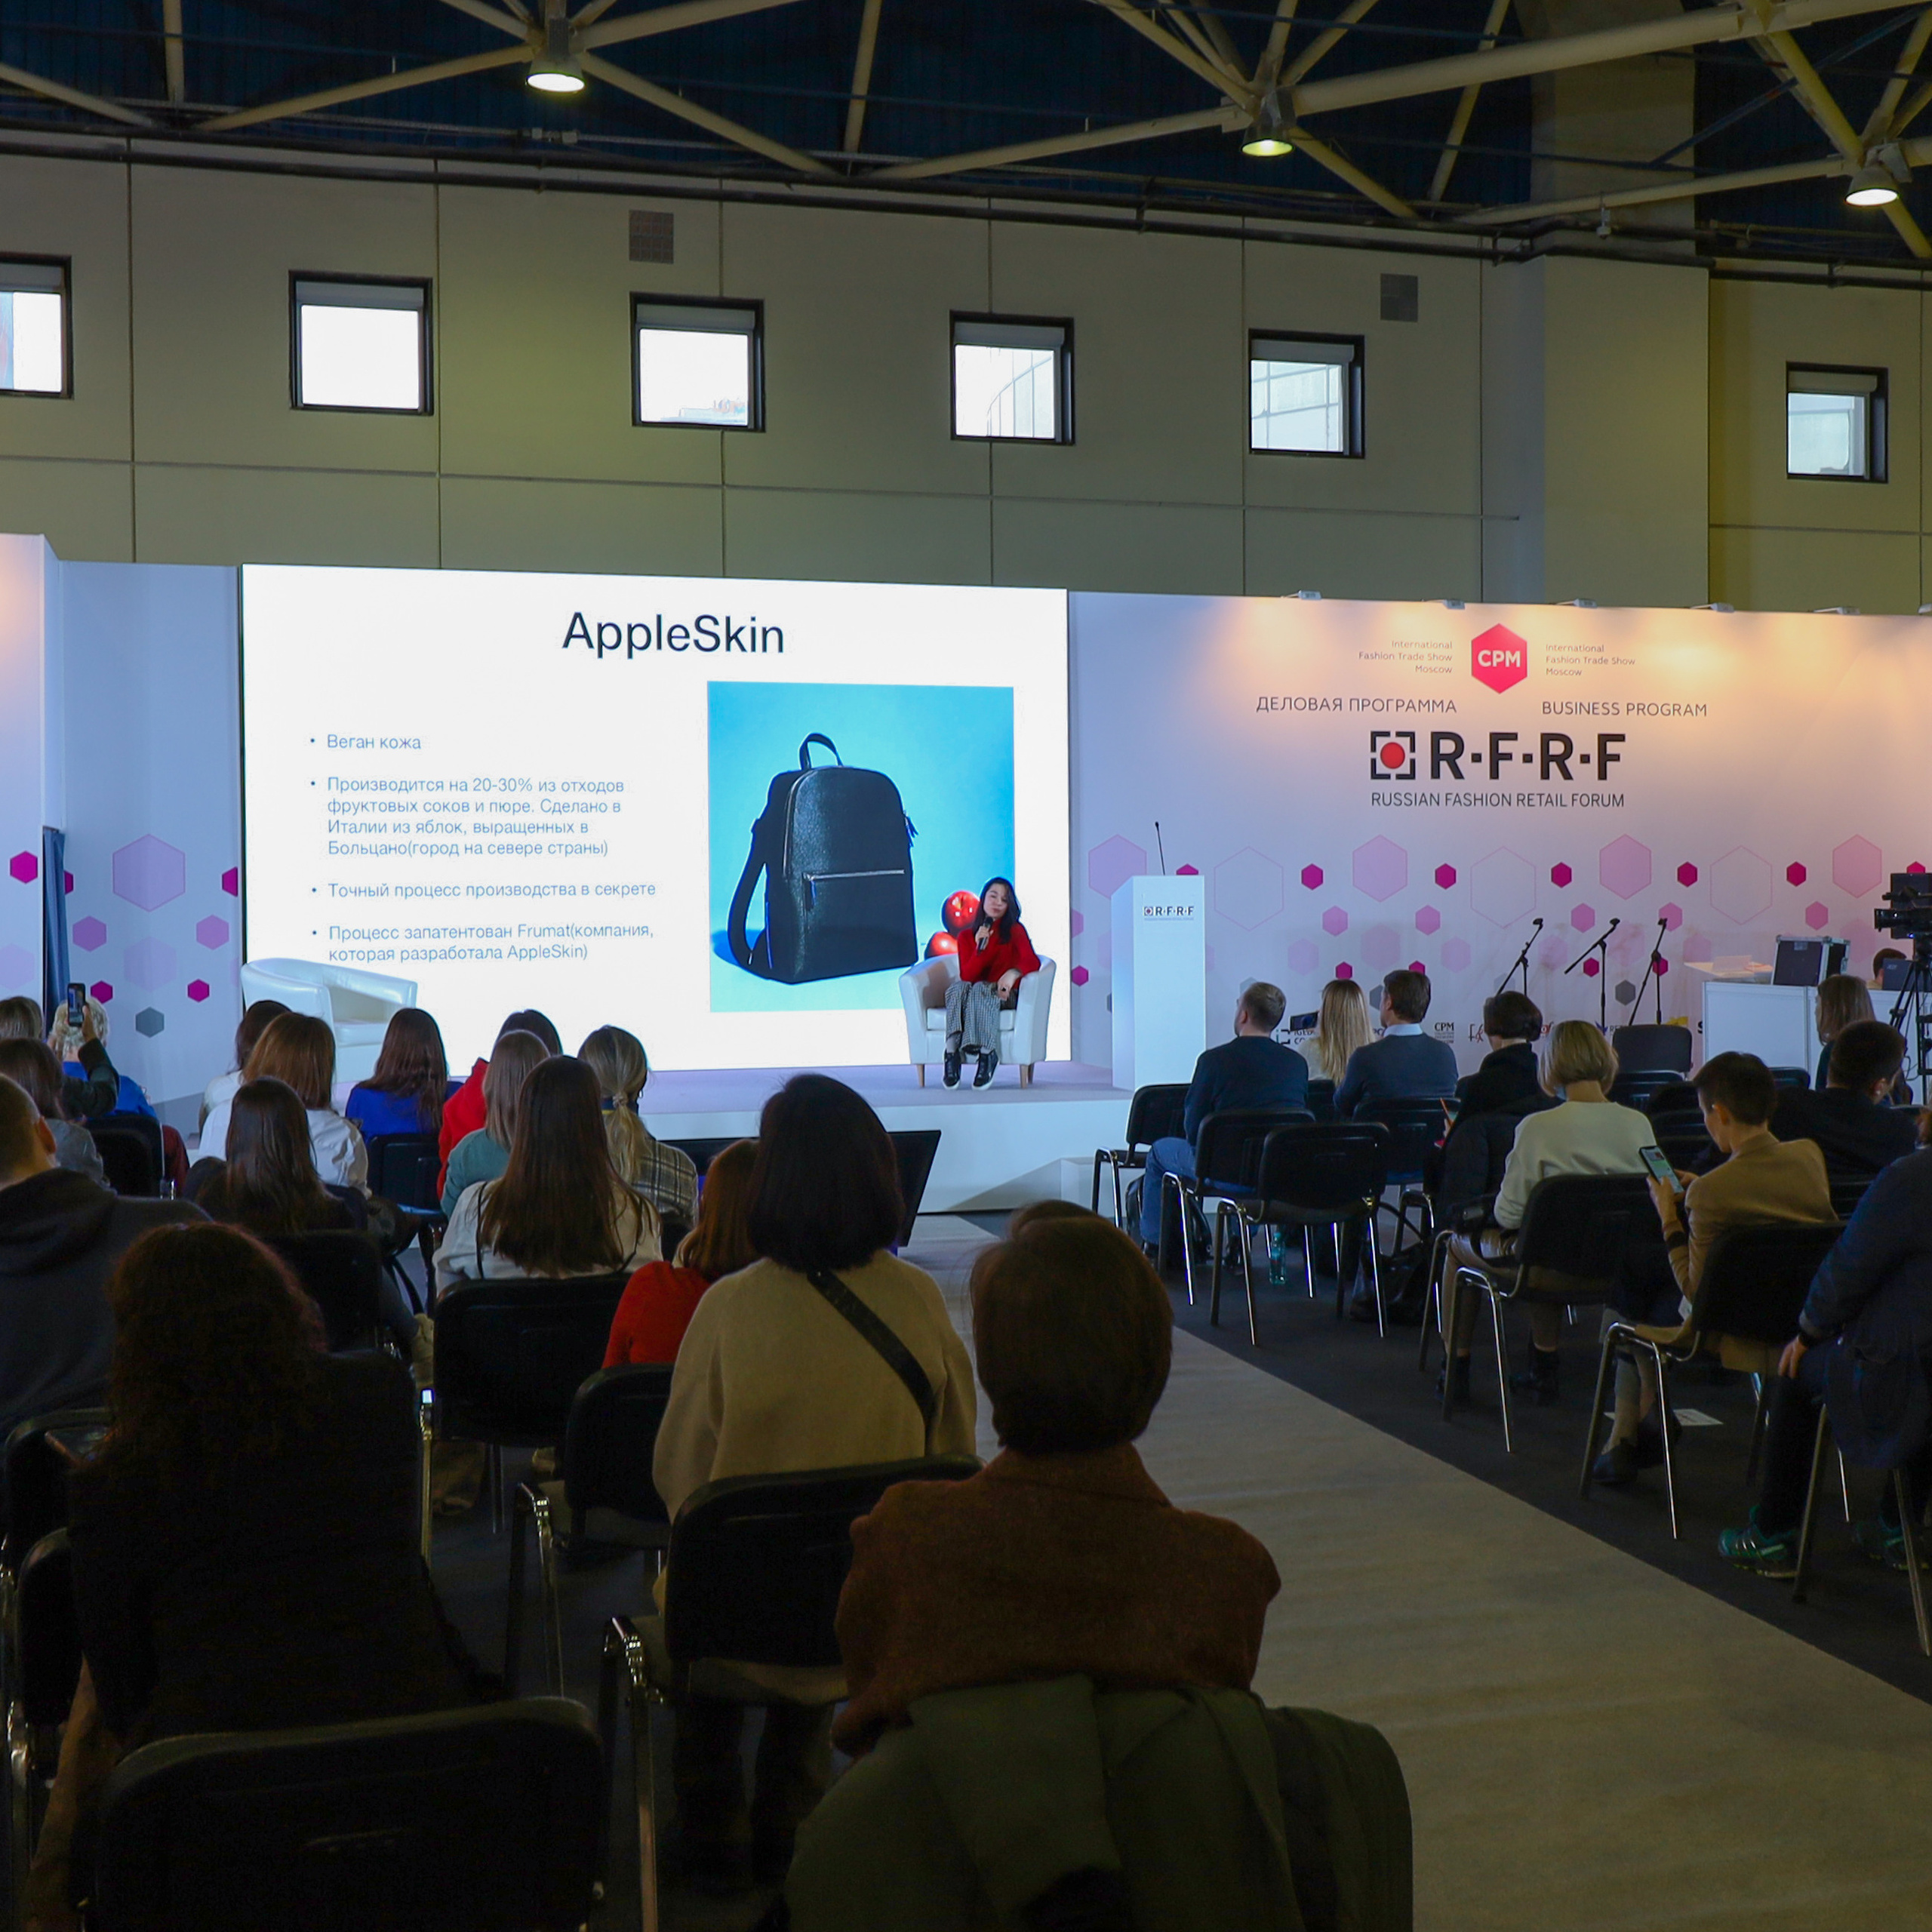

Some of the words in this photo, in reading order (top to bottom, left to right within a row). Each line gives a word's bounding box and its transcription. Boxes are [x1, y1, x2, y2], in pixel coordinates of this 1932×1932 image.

[561, 611, 783, 660] AppleSkin
[1391, 640, 1453, 650] International
[1545, 644, 1605, 653] International
[1358, 651, 1395, 660] Fashion
[1398, 652, 1425, 661] Trade
[1427, 653, 1453, 662] Show
[1477, 649, 1521, 668] CPM
[1545, 655, 1581, 664] Fashion
[1583, 656, 1609, 665] Trade
[1611, 657, 1636, 666] Show
[1415, 665, 1453, 674] Moscow
[1545, 667, 1583, 676] Moscow
[1256, 696, 1343, 713] ДЕЛОВАЯ
[1348, 697, 1457, 714] ПРОГРАММА
[1541, 700, 1620, 716] BUSINESS
[1626, 702, 1707, 717] PROGRAM
[327, 734, 375, 749] Веган
[380, 737, 422, 750] кожа
[328, 776, 445, 794] Производится
[449, 780, 469, 792] на
[472, 777, 533, 792] 20-30%
[538, 781, 557, 792] из
[561, 781, 624, 795] отходов
[328, 798, 418, 817] фруктовых
[423, 801, 470, 814] соков
[475, 801, 485, 813] и
[489, 801, 534, 816] пюре.
[540, 798, 608, 815] Сделано
[612, 802, 621, 813] в
[1371, 792, 1440, 808] RUSSIAN
[1444, 792, 1512, 808] FASHION
[1516, 792, 1568, 808] RETAIL
[1571, 792, 1625, 808] FORUM
[328, 819, 387, 834] Италии
[392, 823, 411, 834] из
[415, 819, 467, 835] яблок,
[473, 823, 575, 837] выращенных
[580, 823, 589, 834] в
[328, 840, 460, 858] Больцано(город
[464, 843, 484, 855] на
[487, 843, 543, 858] севере
[547, 840, 608, 857] страны)
[328, 882, 389, 898] Точный
[394, 885, 461, 900] процесс
[466, 884, 577, 900] производства
[581, 884, 590, 896] в
[594, 884, 656, 899] секрете
[328, 925, 399, 943] Процесс
[405, 927, 512, 940] запатентован
[518, 923, 654, 940] Frumat(компания,
[329, 948, 395, 964] которая
[400, 945, 503, 964] разработала
[506, 943, 588, 961] AppleSkin)
[1434, 1022, 1454, 1031] CPM
